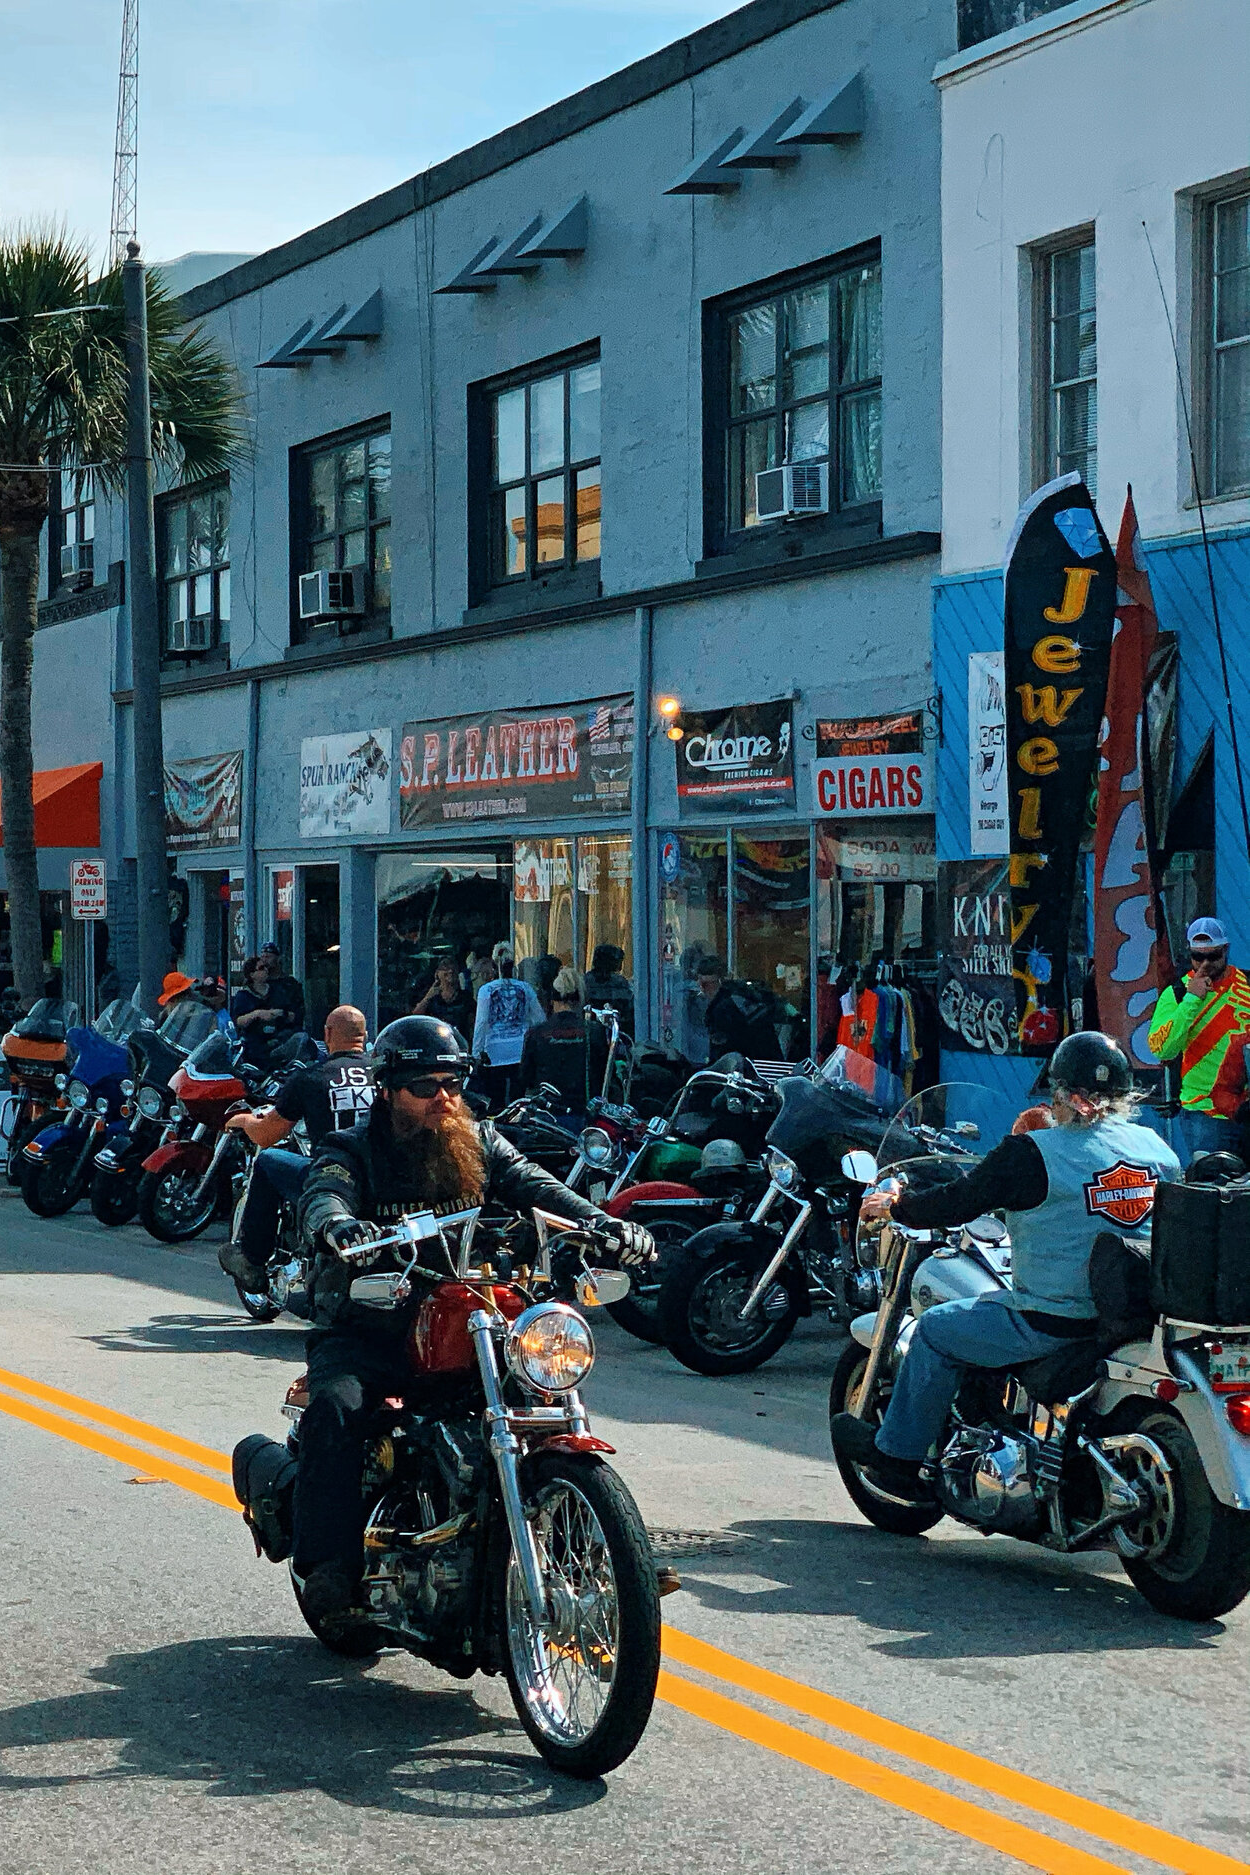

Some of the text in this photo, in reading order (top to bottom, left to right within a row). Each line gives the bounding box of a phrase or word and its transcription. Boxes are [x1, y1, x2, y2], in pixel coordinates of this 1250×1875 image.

[445, 716, 580, 793] LEATHER
[685, 733, 772, 771] Chrome
[302, 764, 323, 787] SPUR
[750, 768, 773, 777] CIGARS
[817, 765, 923, 811] CIGARS
[848, 840, 900, 855] SODA
[954, 895, 1004, 936] KNI
[1095, 1186, 1154, 1204] HARLEY-DAVIDSON
